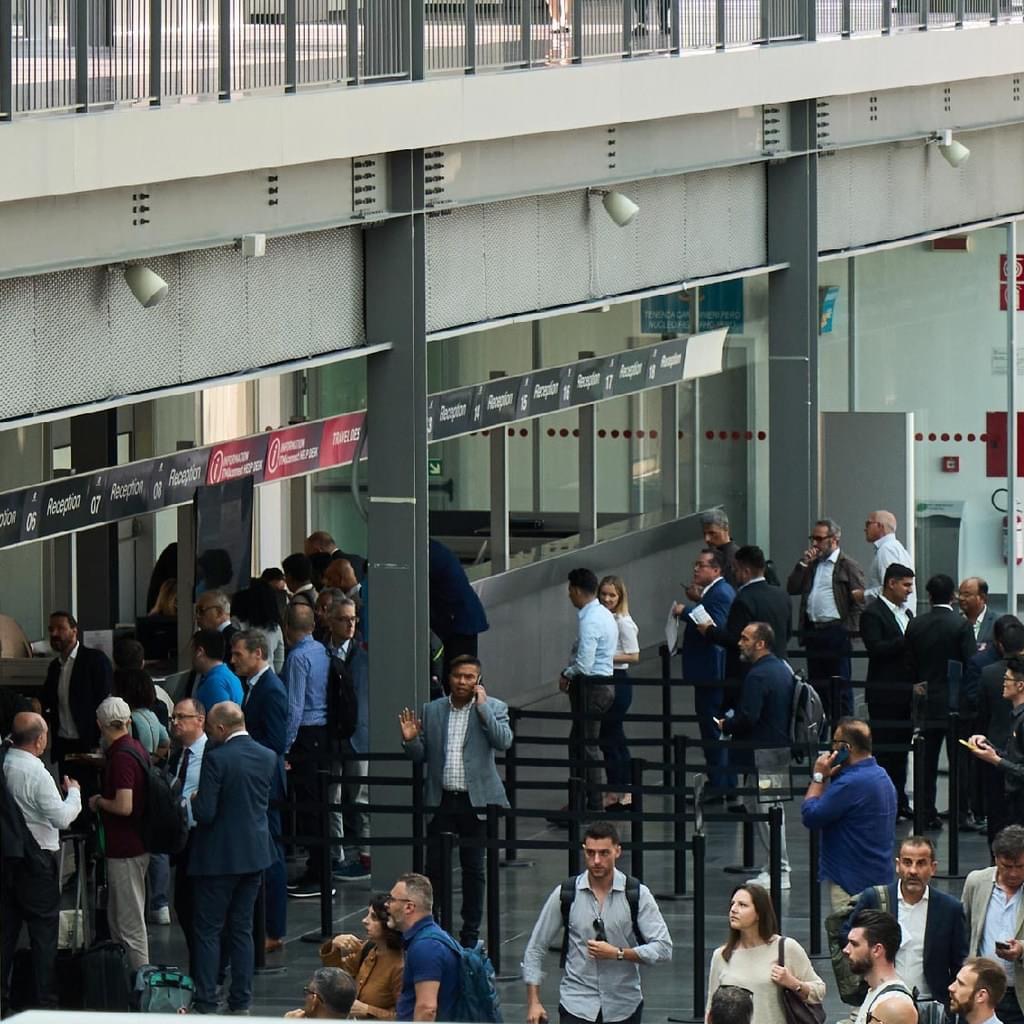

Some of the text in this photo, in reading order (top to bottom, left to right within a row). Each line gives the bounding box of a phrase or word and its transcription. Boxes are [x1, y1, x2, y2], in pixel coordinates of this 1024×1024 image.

[534, 380, 559, 400] Reception
[440, 402, 467, 422] Reception
[488, 391, 513, 412] Reception
[168, 465, 201, 486] Reception
[110, 478, 144, 501] Reception
[46, 492, 81, 516] Reception
[90, 496, 101, 514] 07
